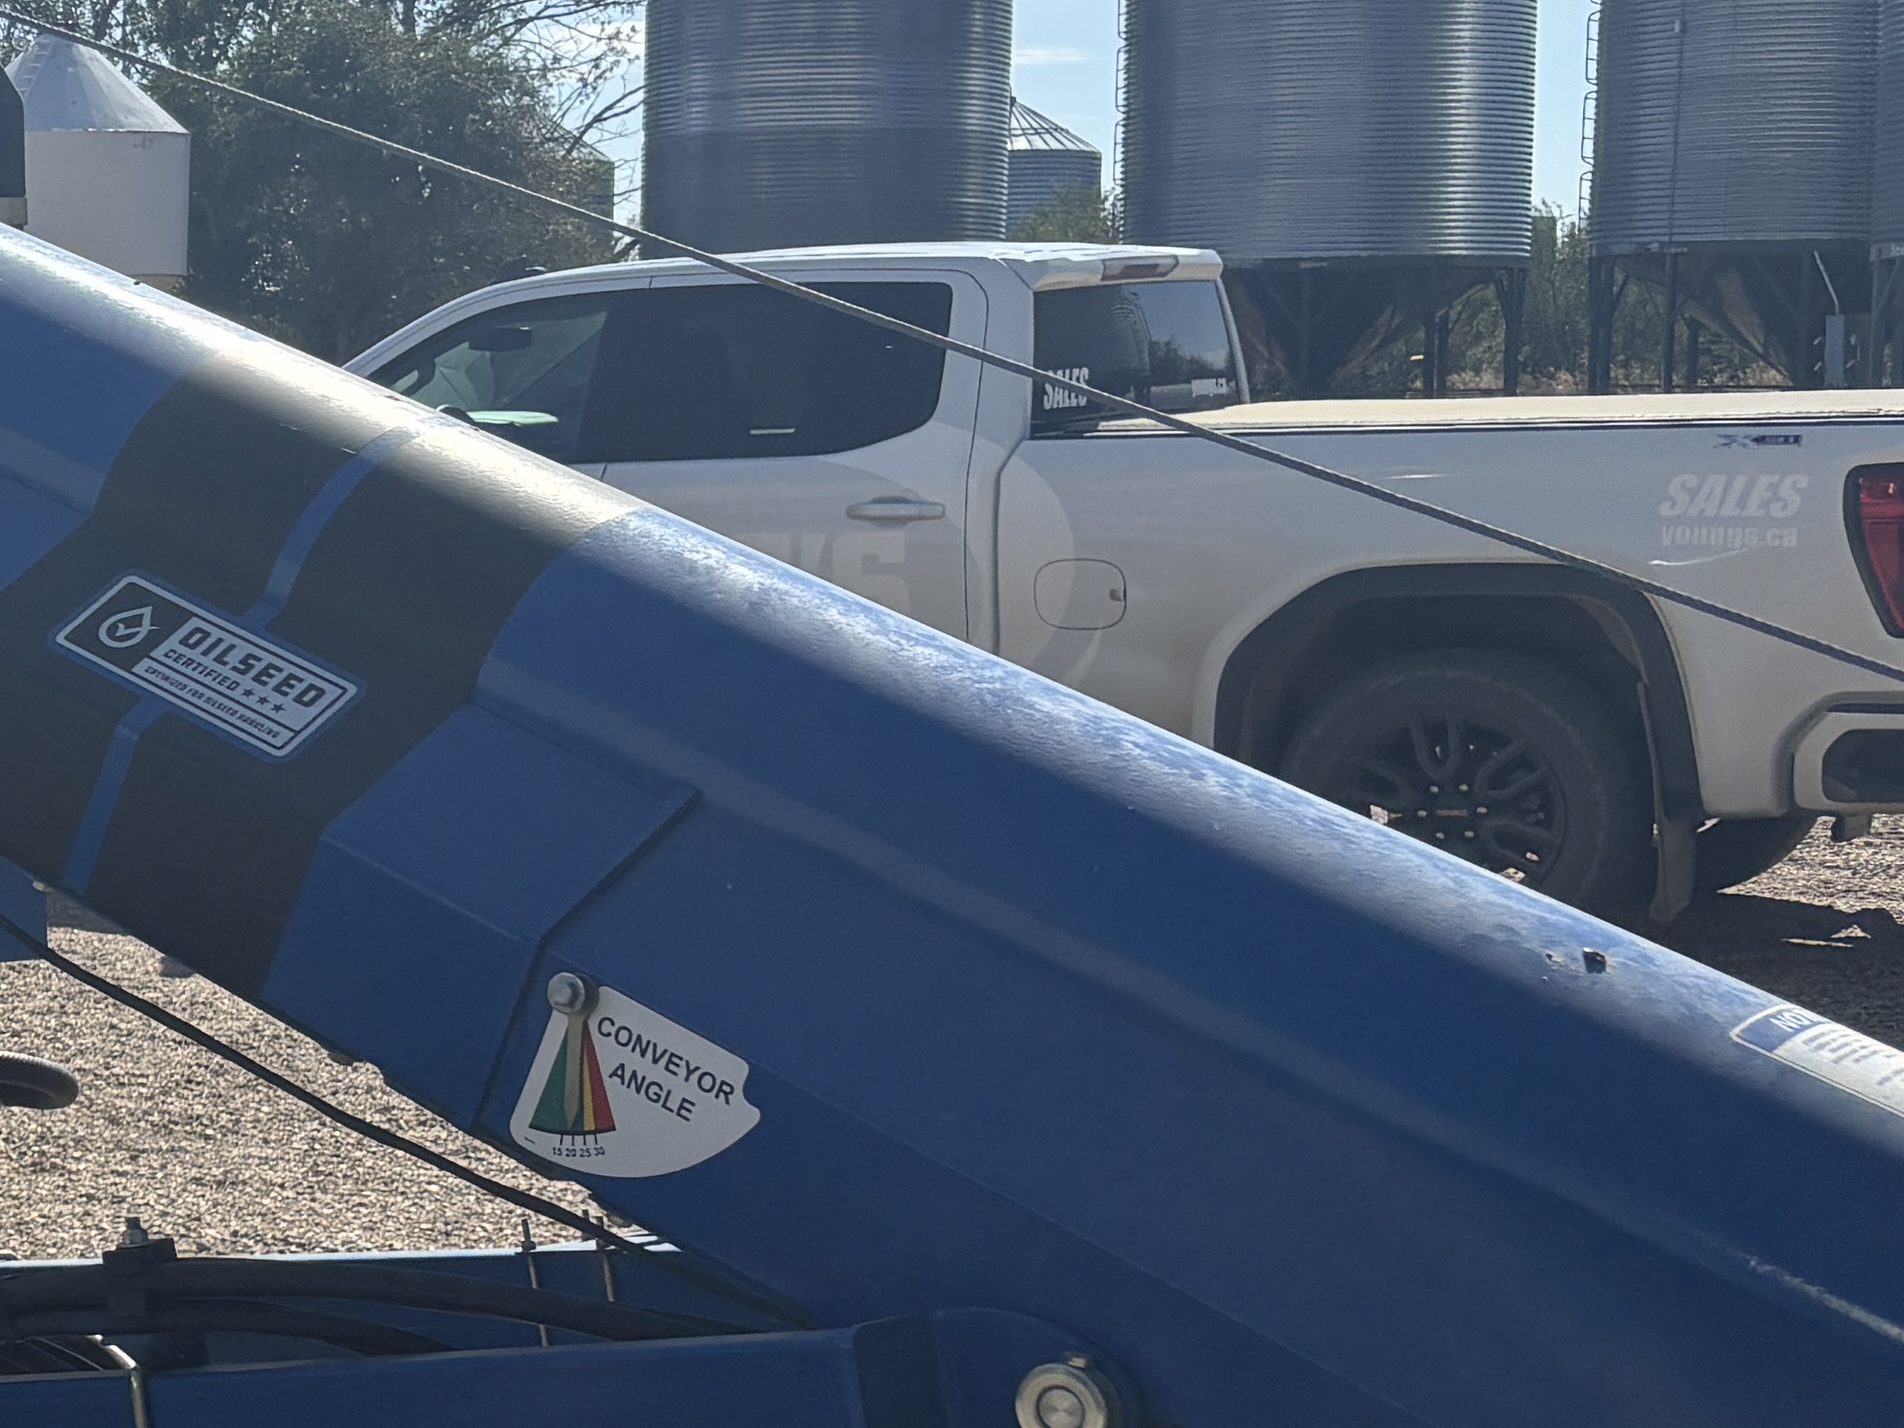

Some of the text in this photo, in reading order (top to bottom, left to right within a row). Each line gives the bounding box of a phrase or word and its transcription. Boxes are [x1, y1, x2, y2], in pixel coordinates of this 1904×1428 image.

[1658, 473, 1809, 518] SALES
[1660, 524, 1798, 549] youngs.ca
[162, 648, 242, 692] CERTIFIED
[177, 625, 328, 709] OILSEED
[597, 1016, 735, 1106] CONVEYOR
[608, 1062, 696, 1122] ANGLE
[565, 1147, 577, 1158] 20
[579, 1147, 591, 1158] 25
